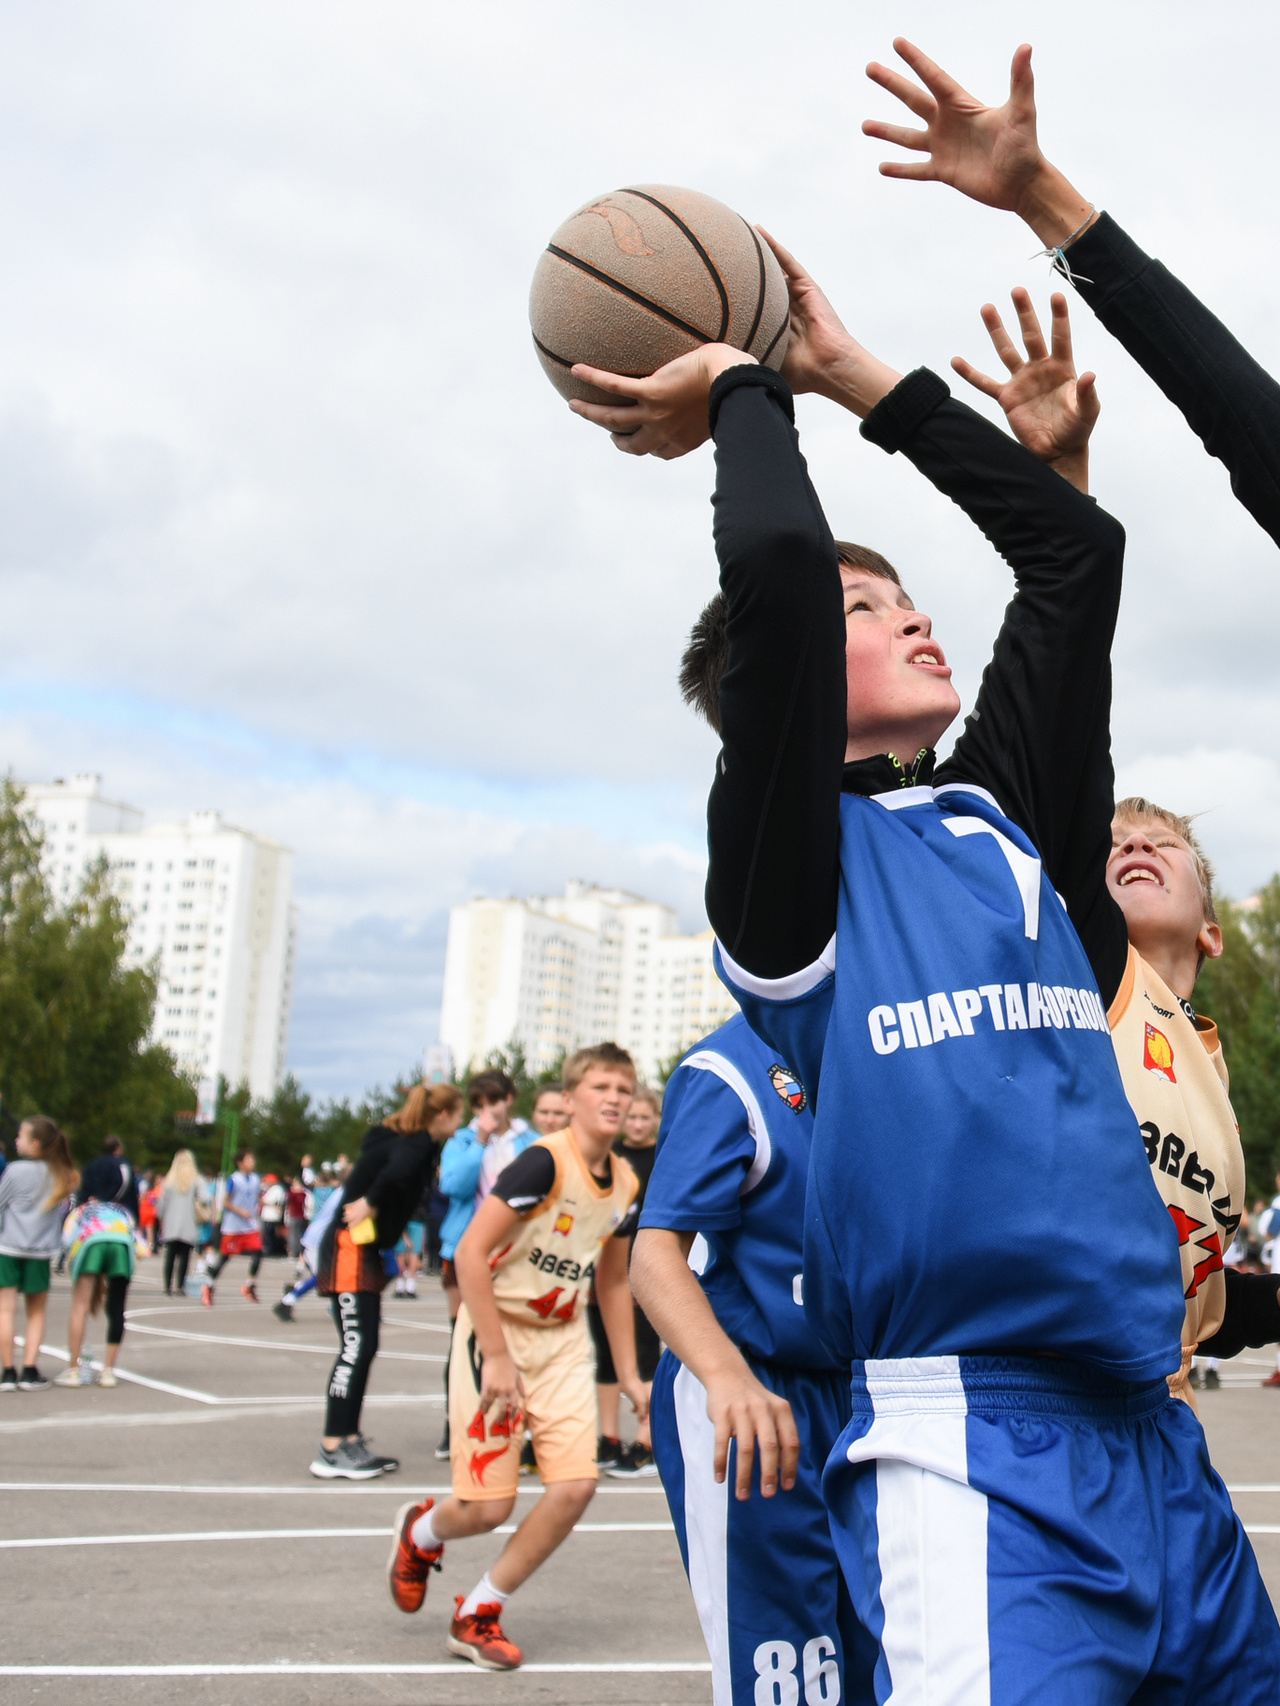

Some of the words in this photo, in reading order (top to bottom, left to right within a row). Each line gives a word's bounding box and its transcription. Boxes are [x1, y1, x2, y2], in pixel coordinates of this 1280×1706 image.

[528, 1247, 596, 1281] ЗВЕЗД
[338, 1291, 361, 1366] OLLOW
[329, 1365, 353, 1399] ME
[753, 1635, 842, 1706] 86
